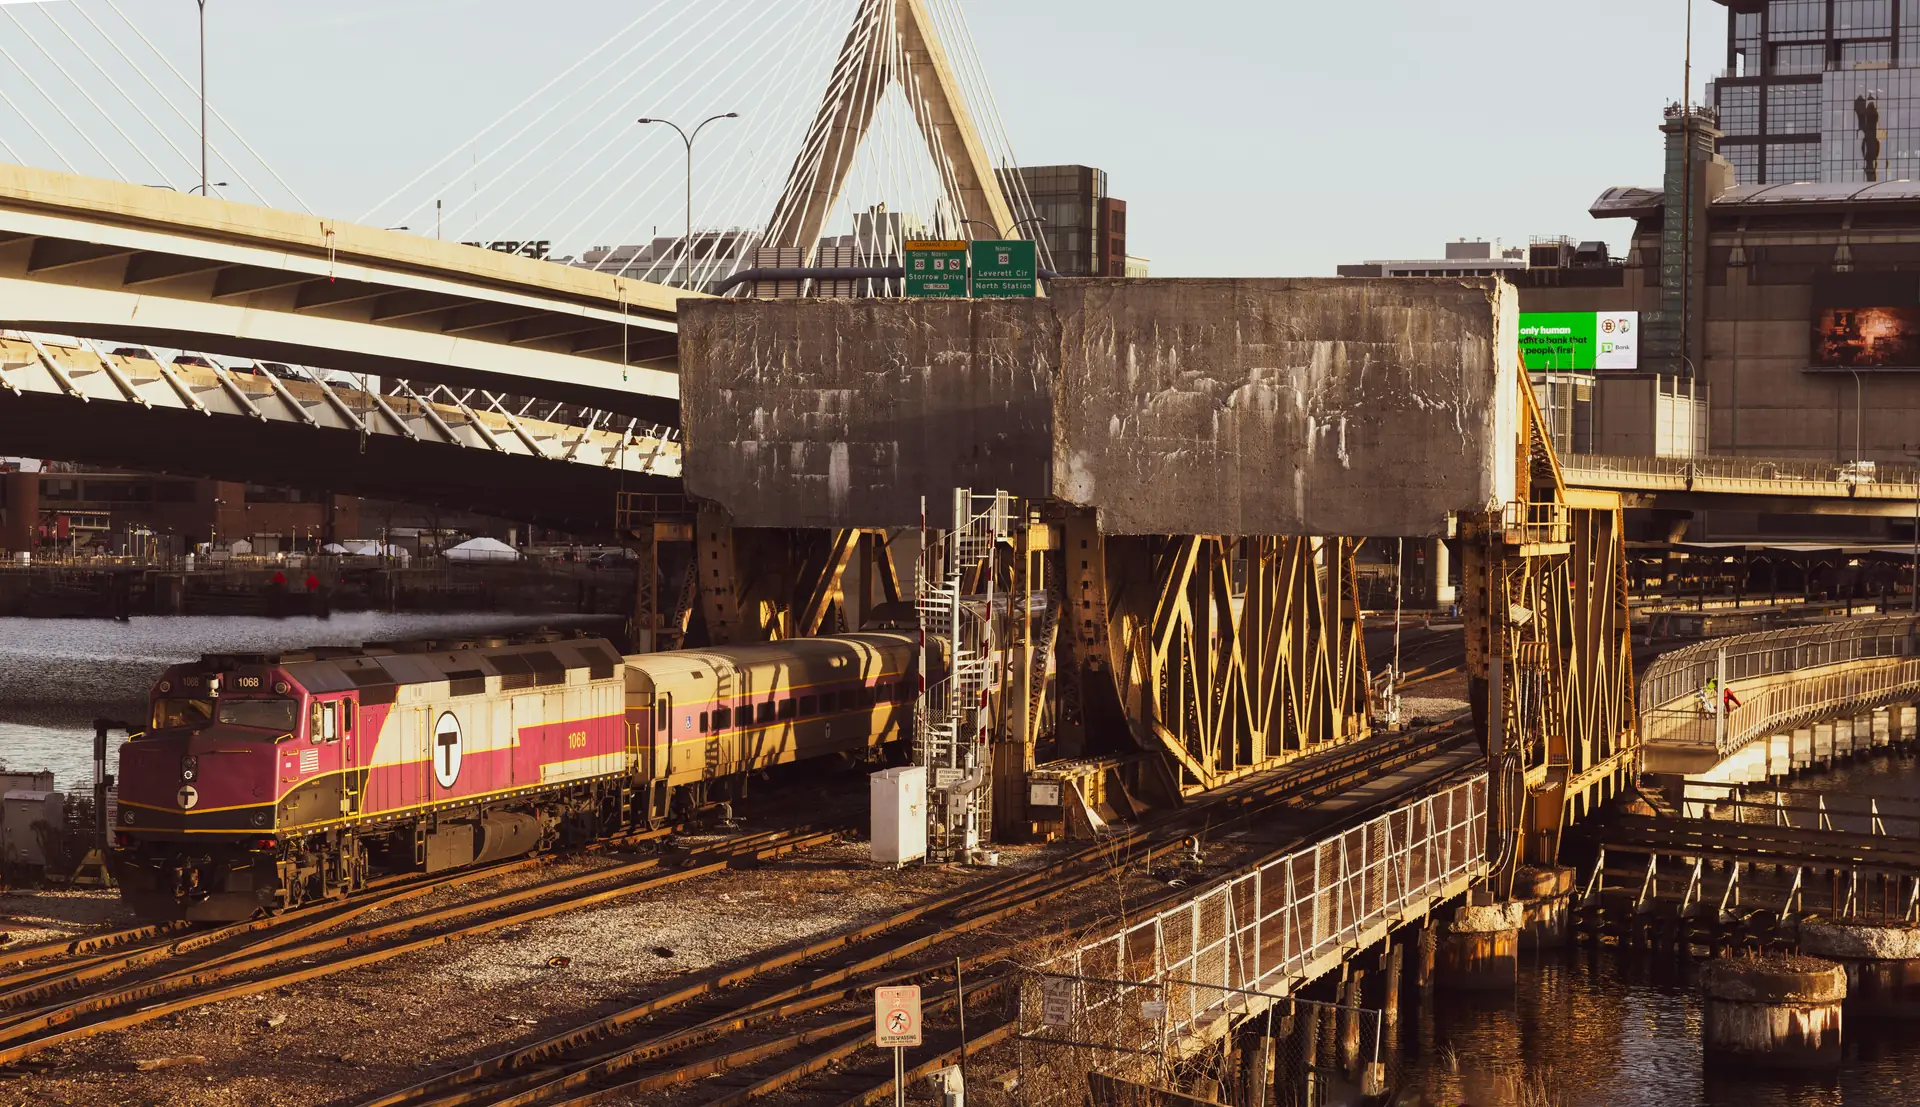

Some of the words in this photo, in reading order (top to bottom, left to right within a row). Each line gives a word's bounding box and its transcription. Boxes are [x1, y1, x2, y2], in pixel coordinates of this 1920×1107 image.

[461, 241, 551, 261] ERSE
[916, 260, 924, 268] 28
[1520, 326, 1540, 336] only
[1540, 326, 1571, 334] human
[1546, 336, 1567, 344] bank
[1569, 336, 1587, 344] that
[1526, 346, 1556, 355] people
[238, 677, 260, 687] 1068
[568, 731, 586, 749] 1068
[438, 732, 457, 776] T
[180, 792, 194, 805] T
